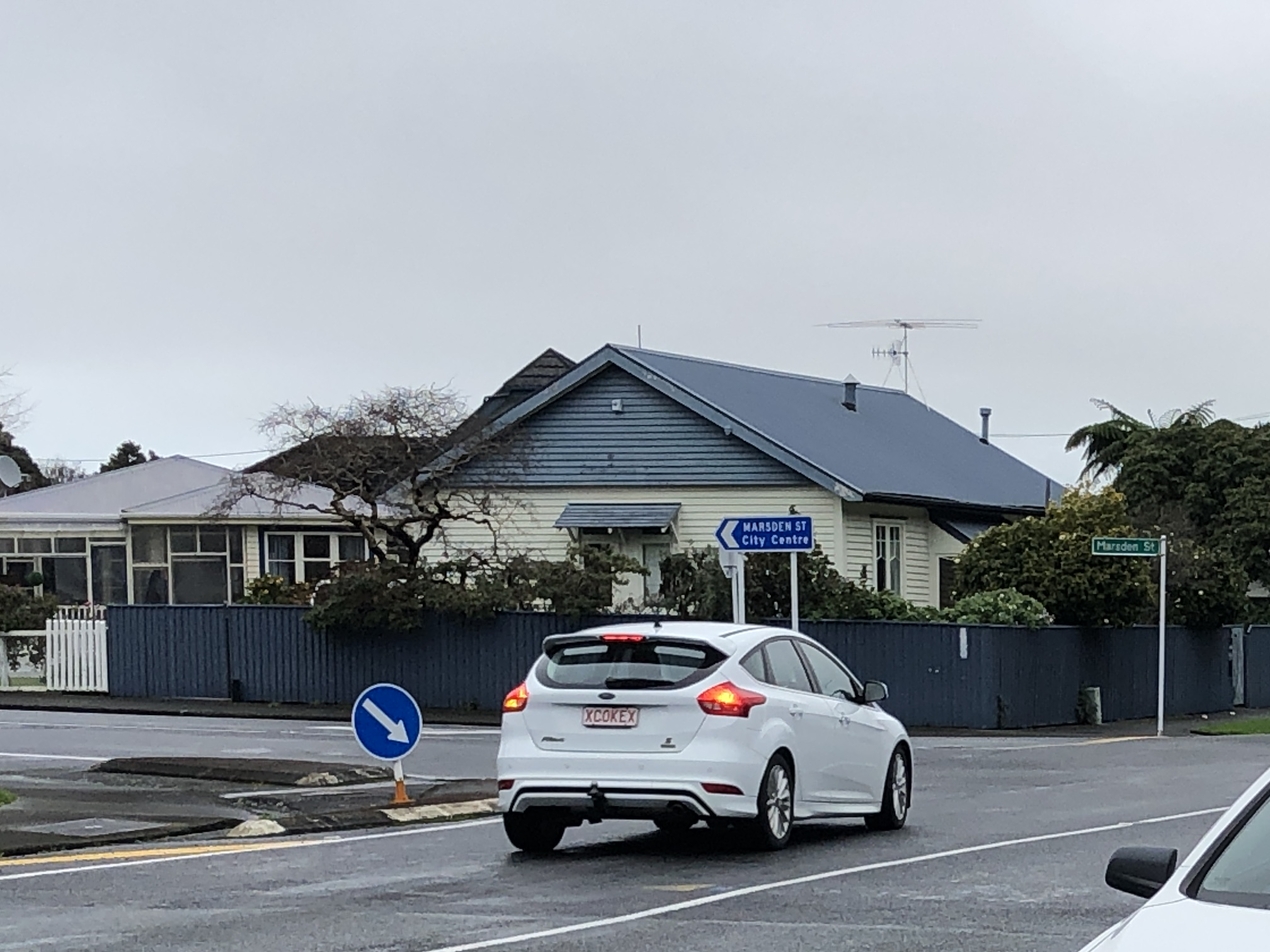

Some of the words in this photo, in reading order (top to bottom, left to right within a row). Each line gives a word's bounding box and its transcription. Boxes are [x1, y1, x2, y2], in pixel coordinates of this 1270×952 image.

[743, 521, 791, 532] MARSDEN
[795, 521, 807, 531] ST
[742, 535, 765, 547] City
[771, 534, 809, 545] Centre
[1096, 541, 1138, 551] Marsden
[1143, 541, 1155, 551] St
